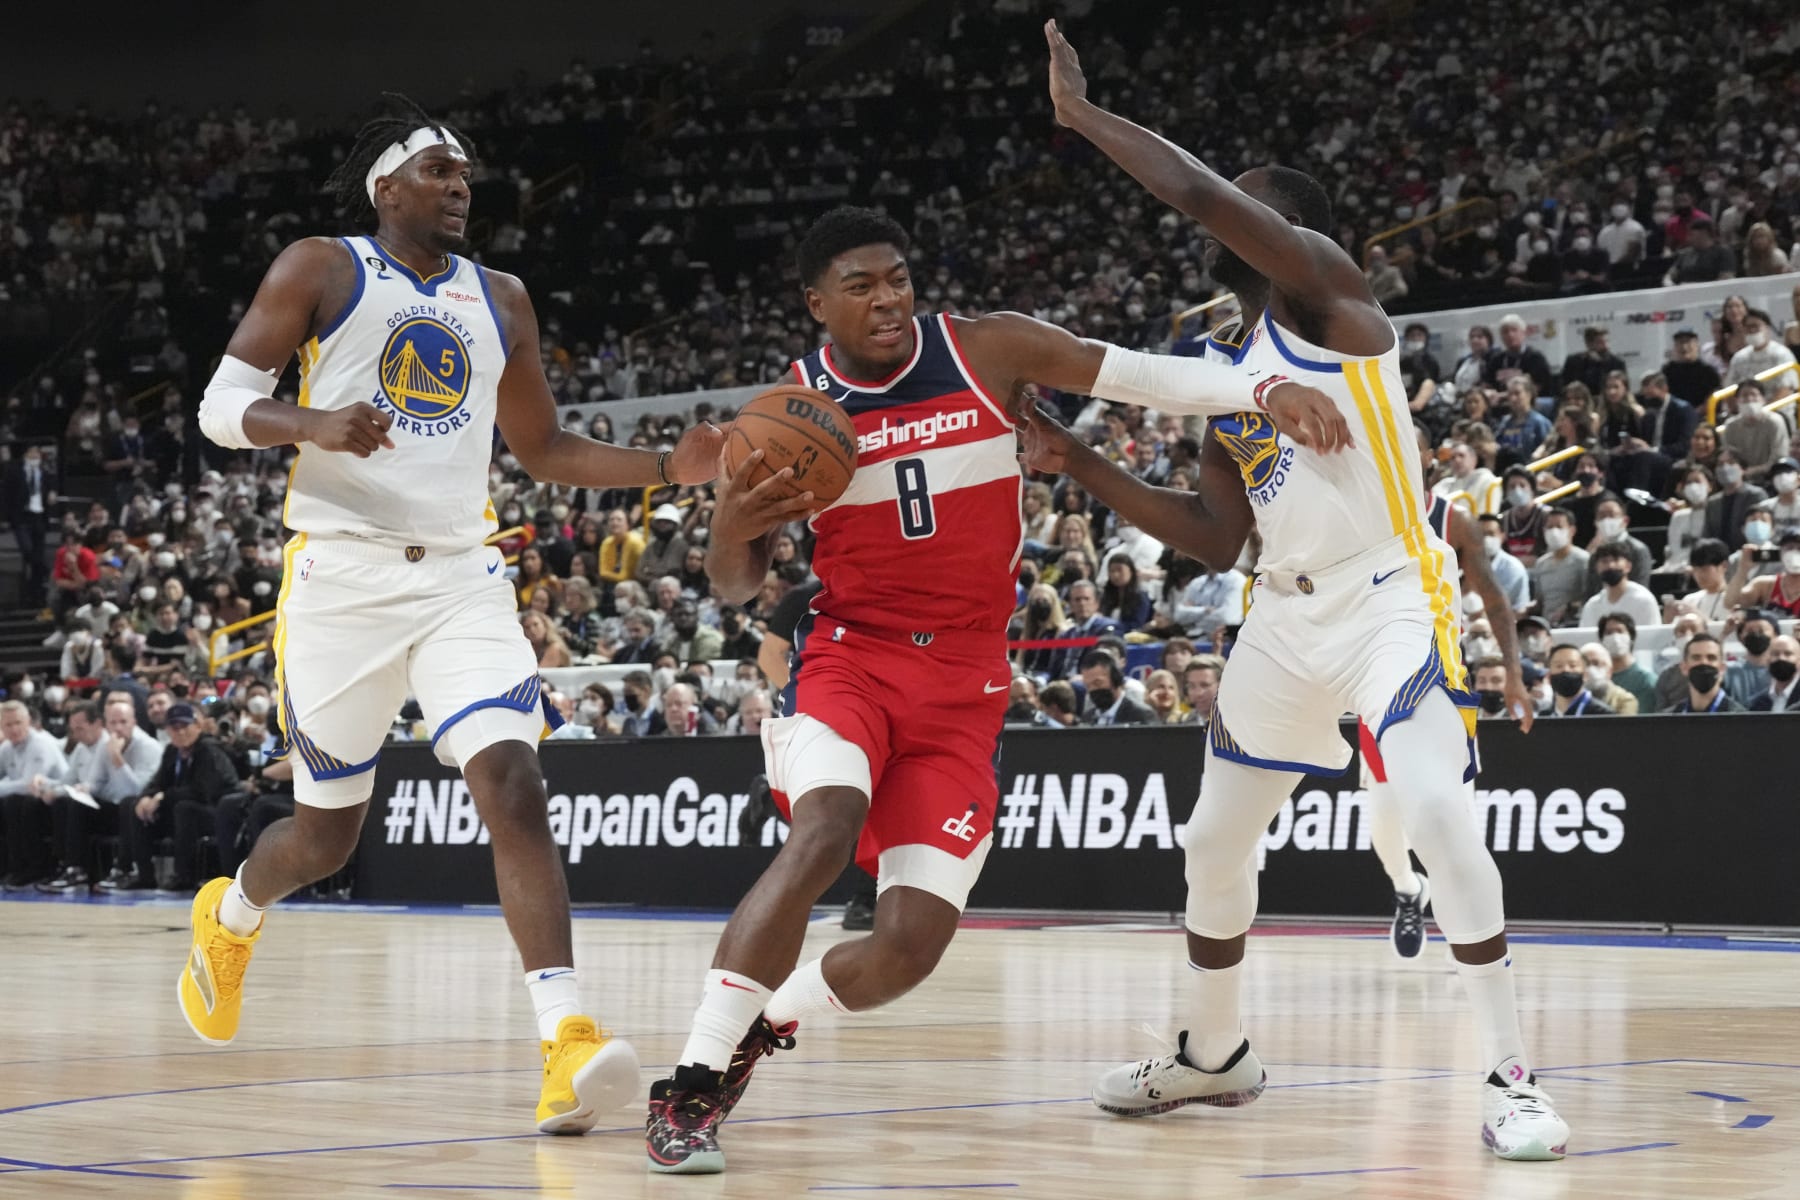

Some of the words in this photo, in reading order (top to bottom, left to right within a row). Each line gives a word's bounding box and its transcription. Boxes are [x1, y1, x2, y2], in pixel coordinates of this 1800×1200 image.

[445, 290, 481, 303] Rakuten
[387, 305, 437, 329] GOLDEN
[441, 311, 476, 349] STATE
[439, 348, 456, 378] 5
[816, 373, 830, 391] 6
[785, 397, 854, 460] Wilson
[857, 409, 978, 454] ashington
[894, 457, 937, 541] 8
[1000, 772, 1627, 872] #NBApanmes
